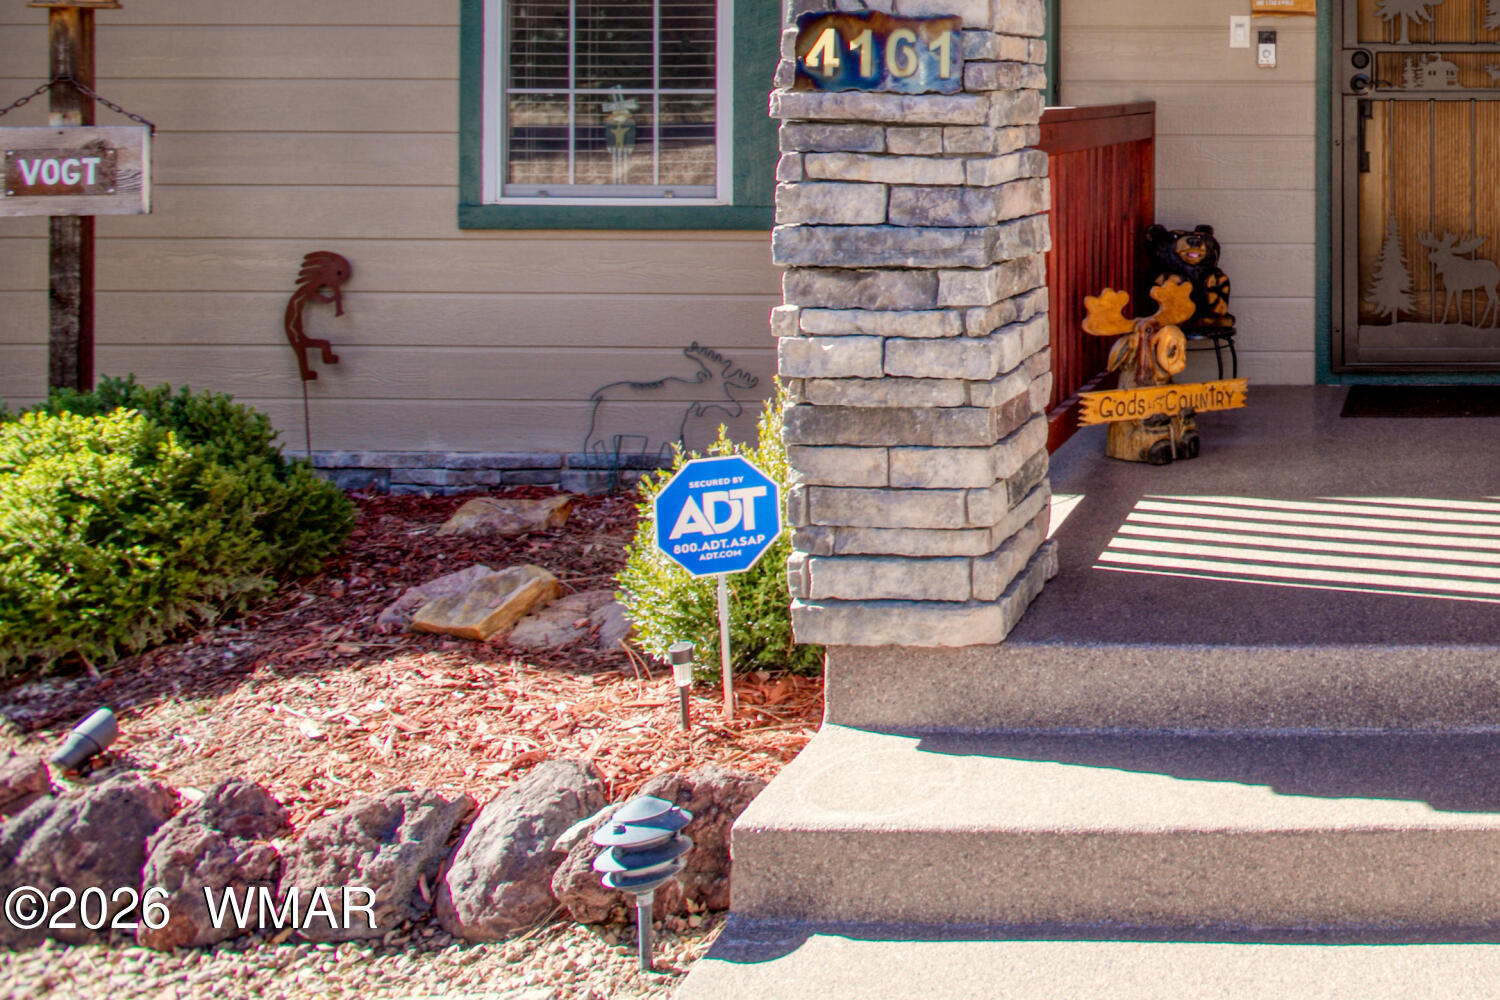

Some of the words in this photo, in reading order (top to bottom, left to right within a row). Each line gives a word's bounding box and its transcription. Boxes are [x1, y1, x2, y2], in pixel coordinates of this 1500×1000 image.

[804, 27, 951, 79] 4161
[17, 157, 101, 186] VOGT
[1099, 391, 1146, 418] Gods
[688, 478, 731, 489] SECURED
[732, 476, 744, 484] BY
[669, 485, 767, 540] ADT
[673, 534, 766, 555] 800.ADT.ASAP
[698, 550, 742, 562] ADT.COM
